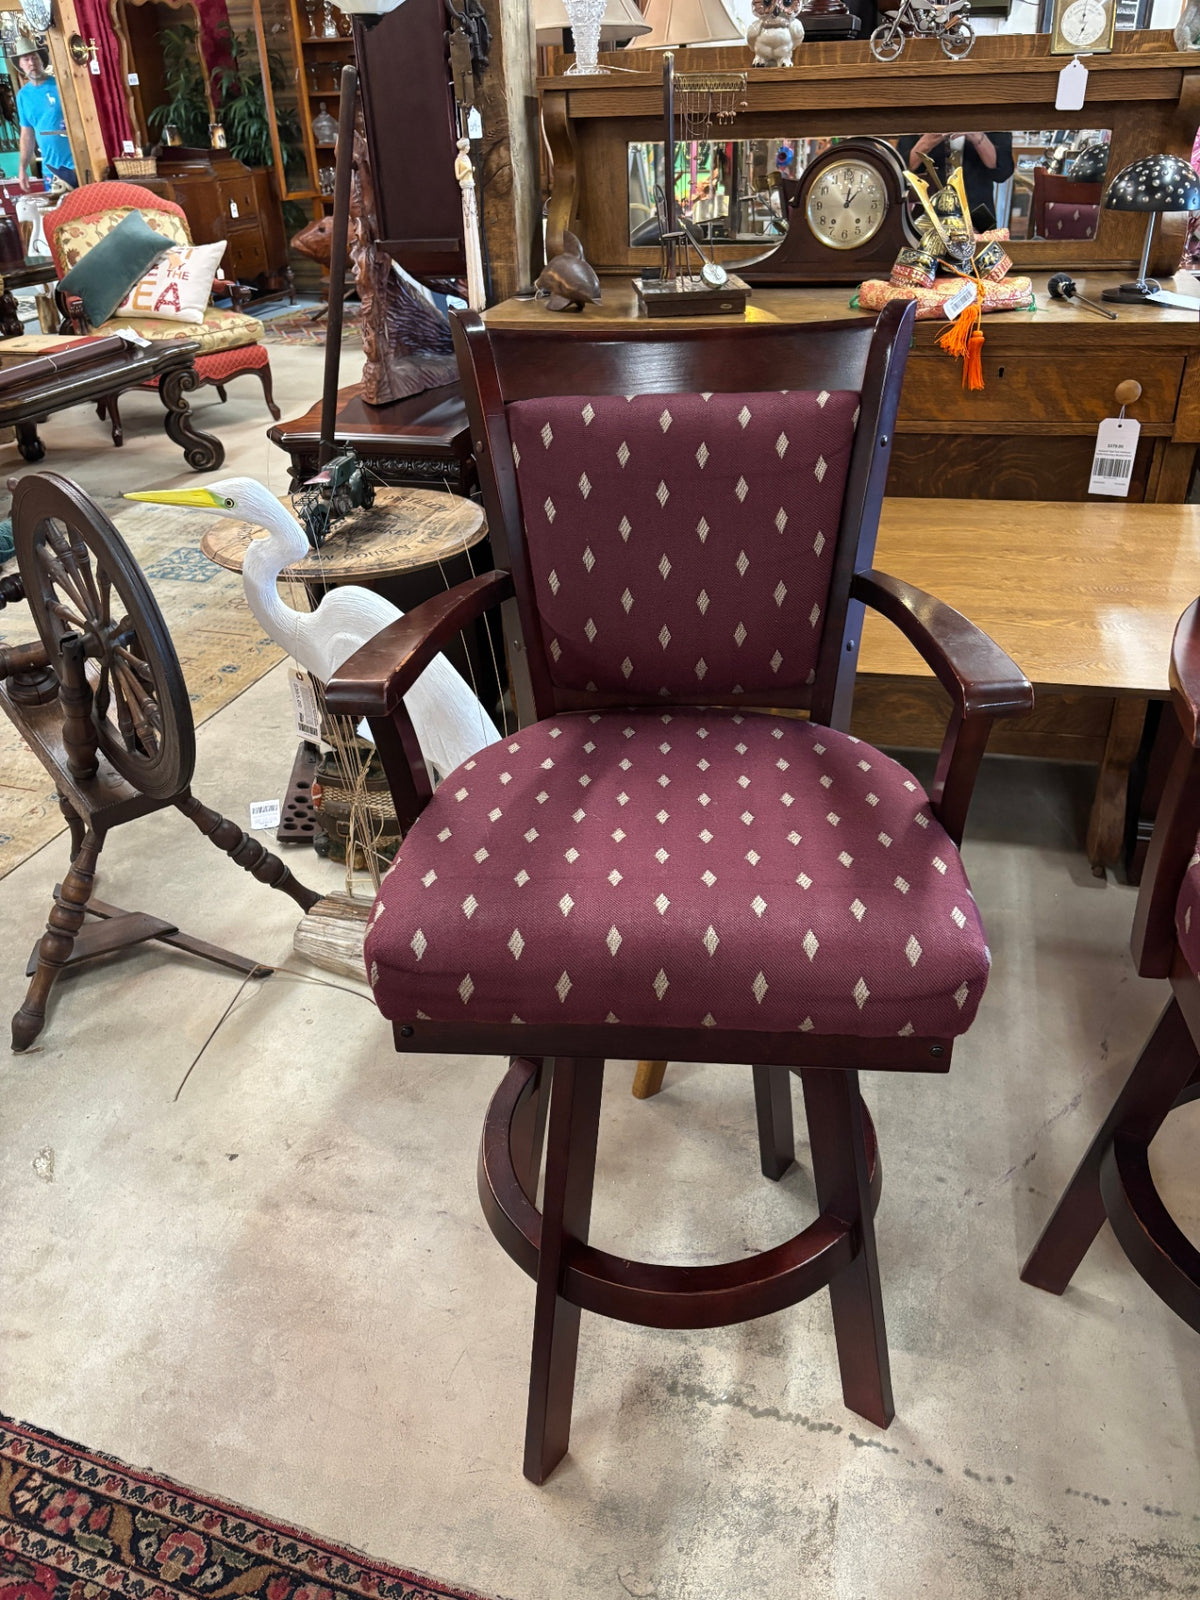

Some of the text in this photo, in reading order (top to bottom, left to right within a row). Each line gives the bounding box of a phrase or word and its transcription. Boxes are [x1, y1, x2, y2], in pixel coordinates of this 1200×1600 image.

[816, 201, 823, 211] 9
[819, 215, 826, 226] 8
[828, 226, 836, 236] 7
[841, 230, 848, 240] 6
[854, 226, 862, 236] 5
[166, 269, 190, 281] THE
